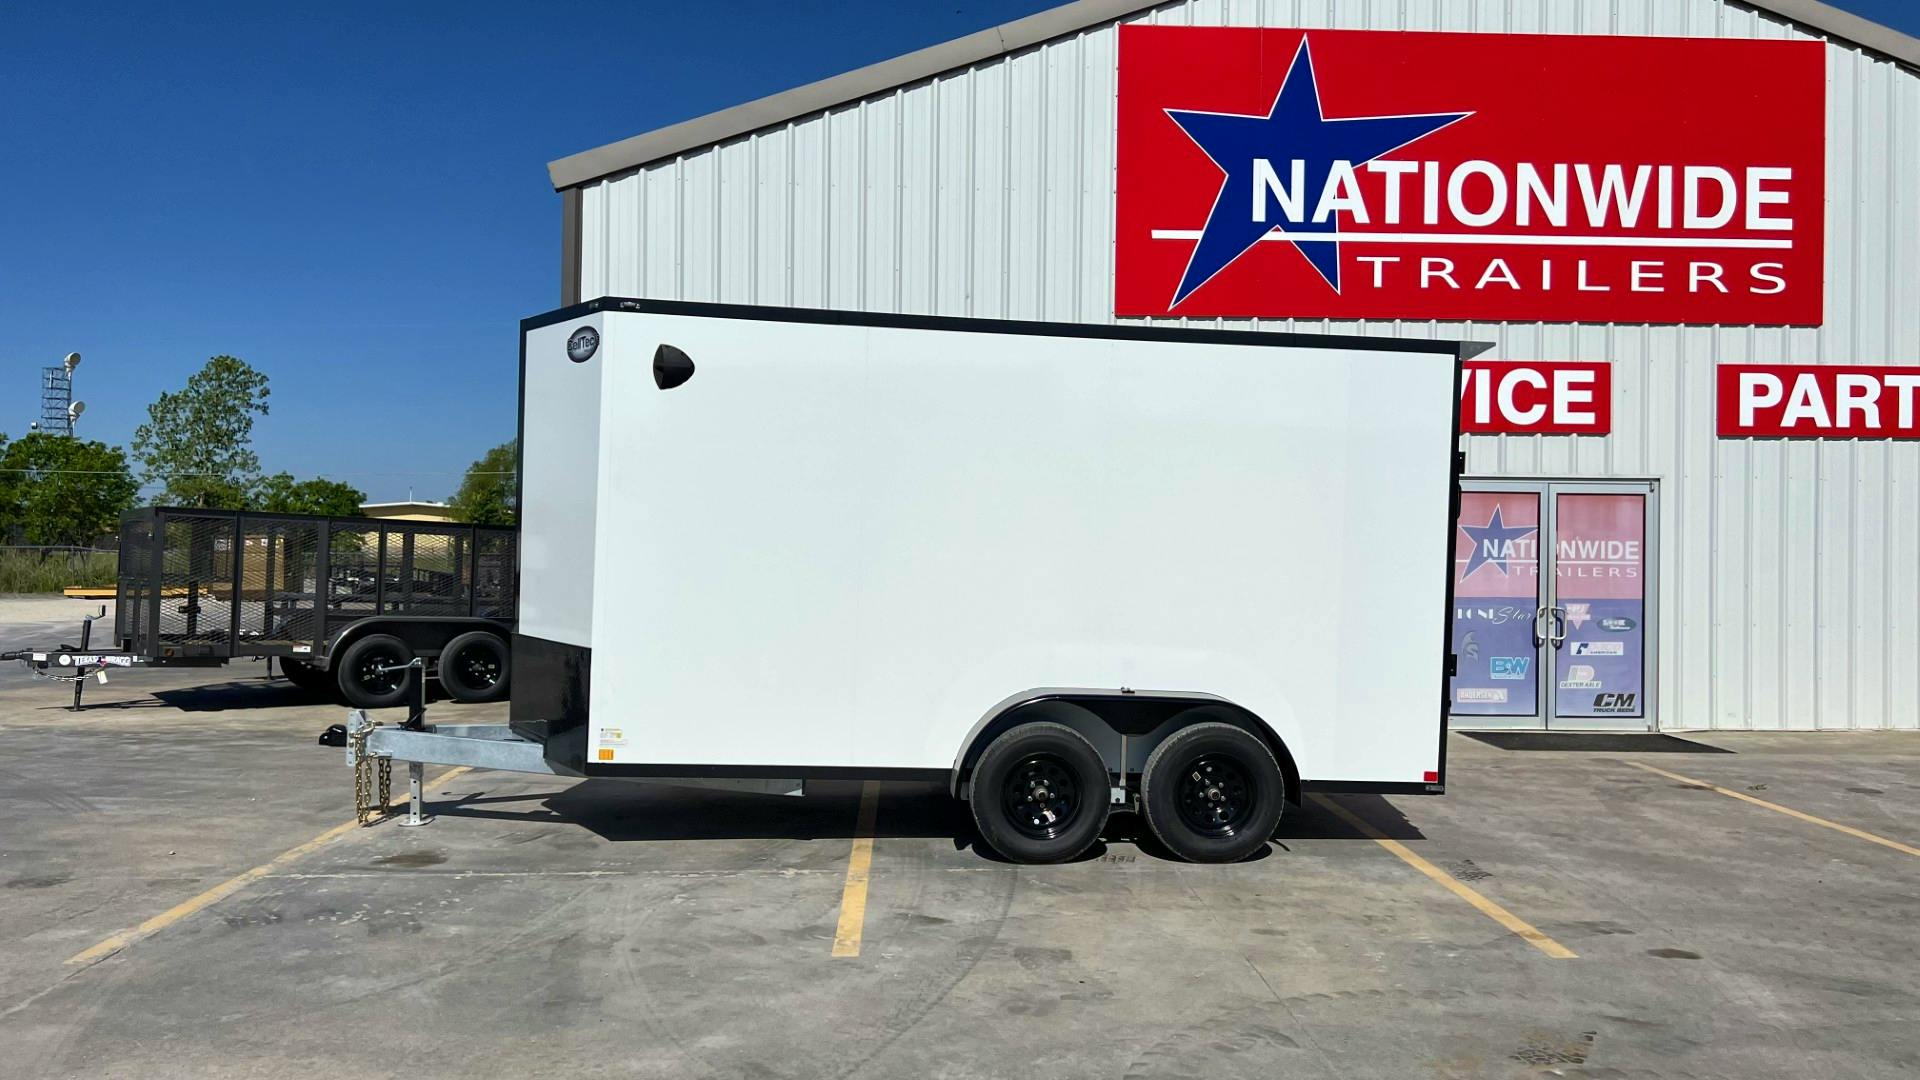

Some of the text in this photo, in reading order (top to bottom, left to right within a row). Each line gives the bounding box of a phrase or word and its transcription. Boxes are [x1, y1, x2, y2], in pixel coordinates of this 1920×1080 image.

[1252, 158, 1793, 231] NATIONWIDE
[1356, 256, 1787, 294] TRAILERS
[1461, 368, 1596, 426] ICE
[1739, 372, 1920, 429] PART
[1483, 539, 1639, 560] NATINWIDE
[1593, 693, 1636, 707] CM
